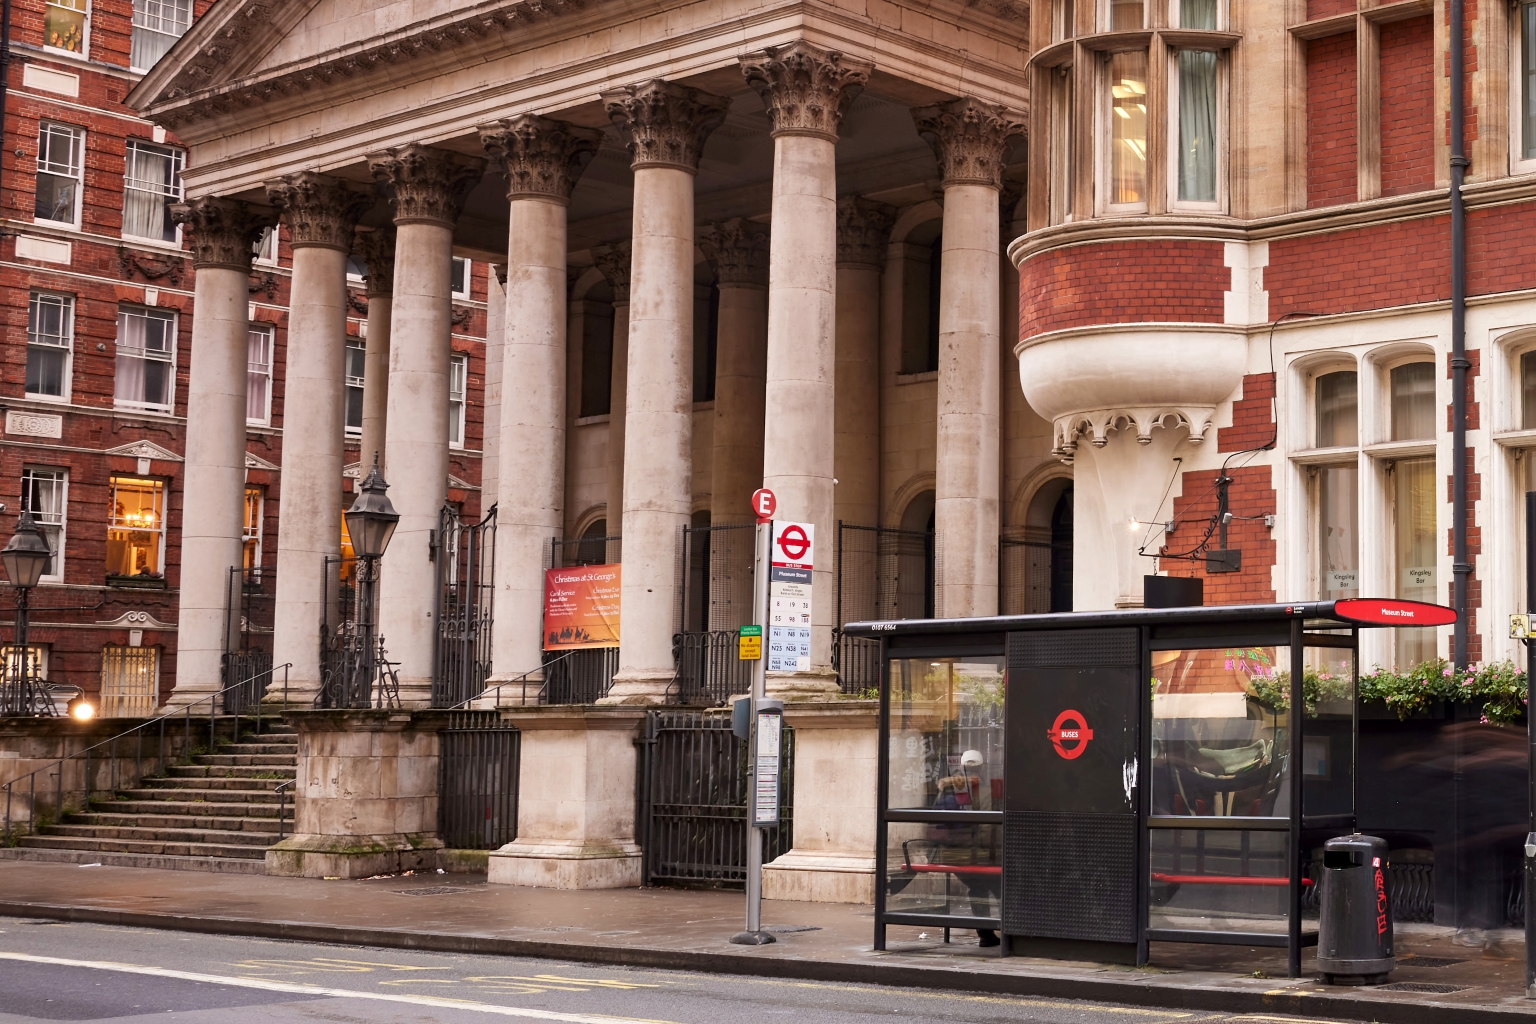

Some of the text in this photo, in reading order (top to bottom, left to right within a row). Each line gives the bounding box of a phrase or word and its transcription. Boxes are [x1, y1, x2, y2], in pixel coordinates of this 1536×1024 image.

[760, 492, 771, 514] E
[554, 574, 580, 584] Christmas
[593, 572, 616, 582] George's
[592, 586, 611, 594] Christmas
[1381, 608, 1400, 616] Museum
